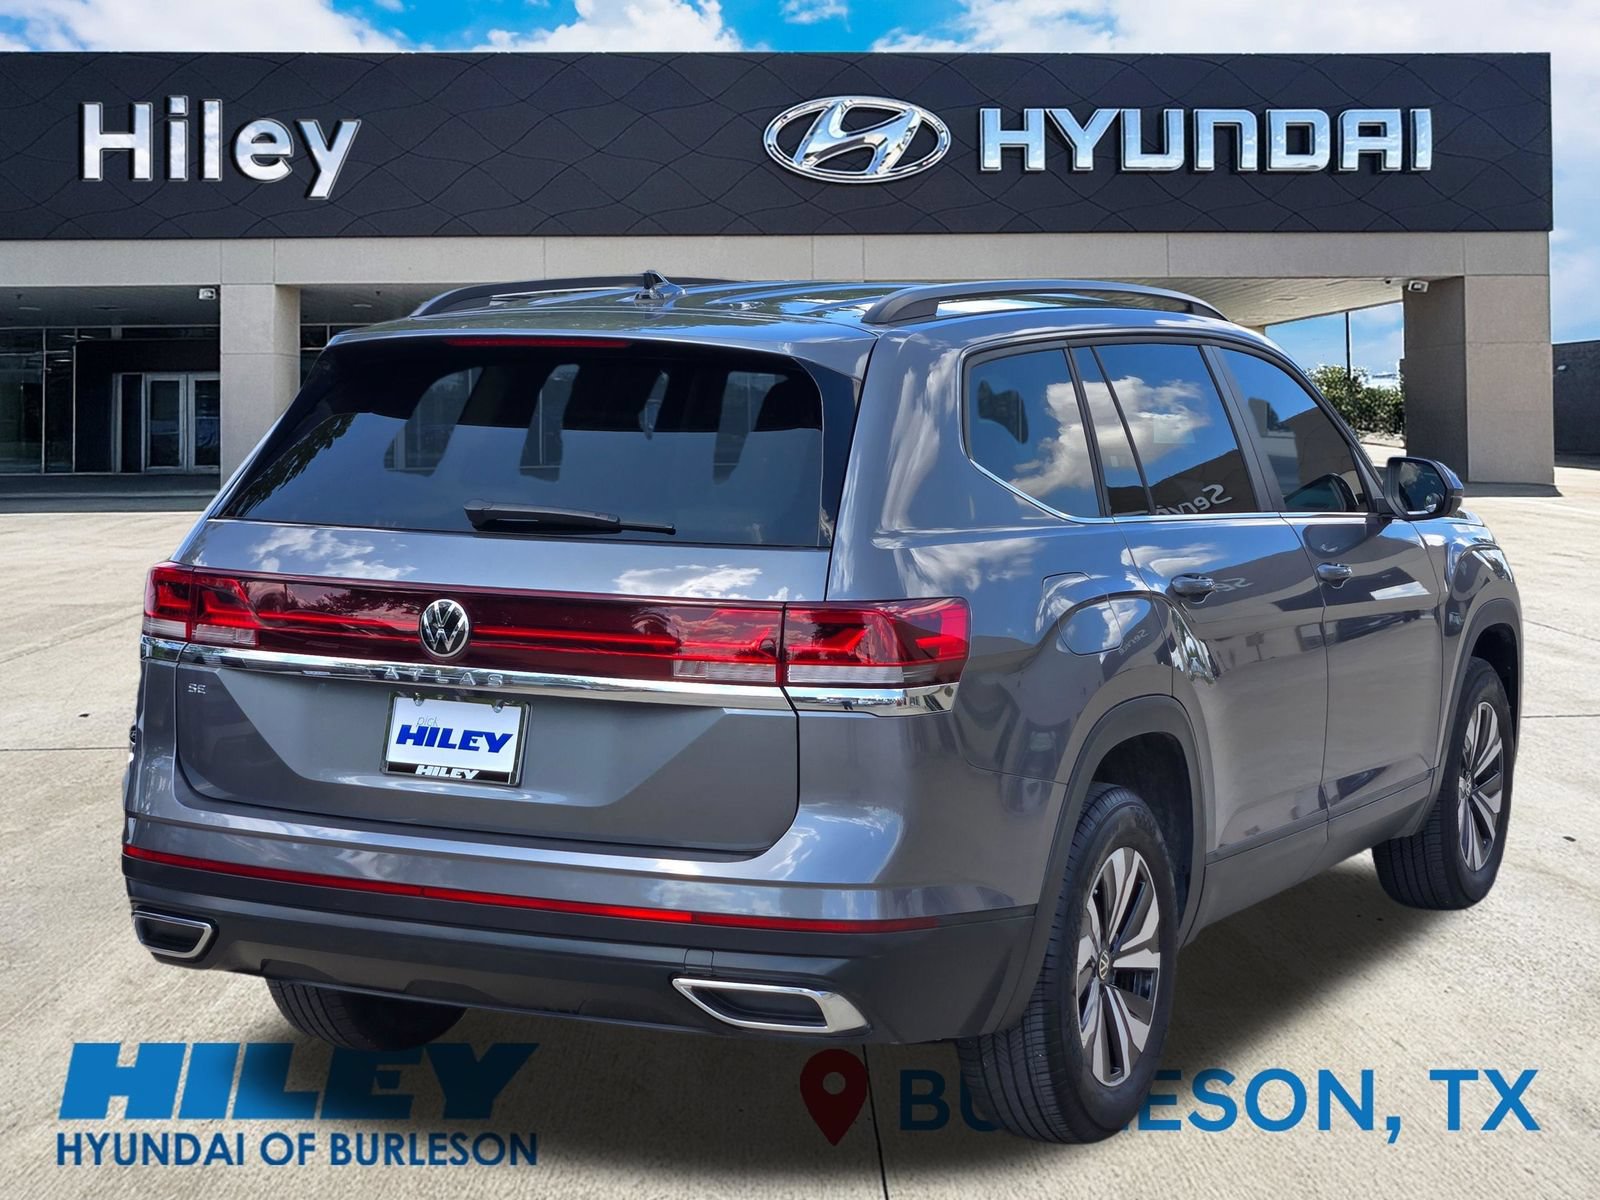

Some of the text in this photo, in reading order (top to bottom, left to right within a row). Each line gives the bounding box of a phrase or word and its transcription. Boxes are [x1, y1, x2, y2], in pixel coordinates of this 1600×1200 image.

[79, 95, 361, 199] Hiley
[979, 108, 1433, 172] HYUNDAI
[187, 683, 206, 694] SE
[383, 666, 504, 688] ATLAS
[396, 724, 513, 753] HILEY
[415, 764, 480, 780] HILEY
